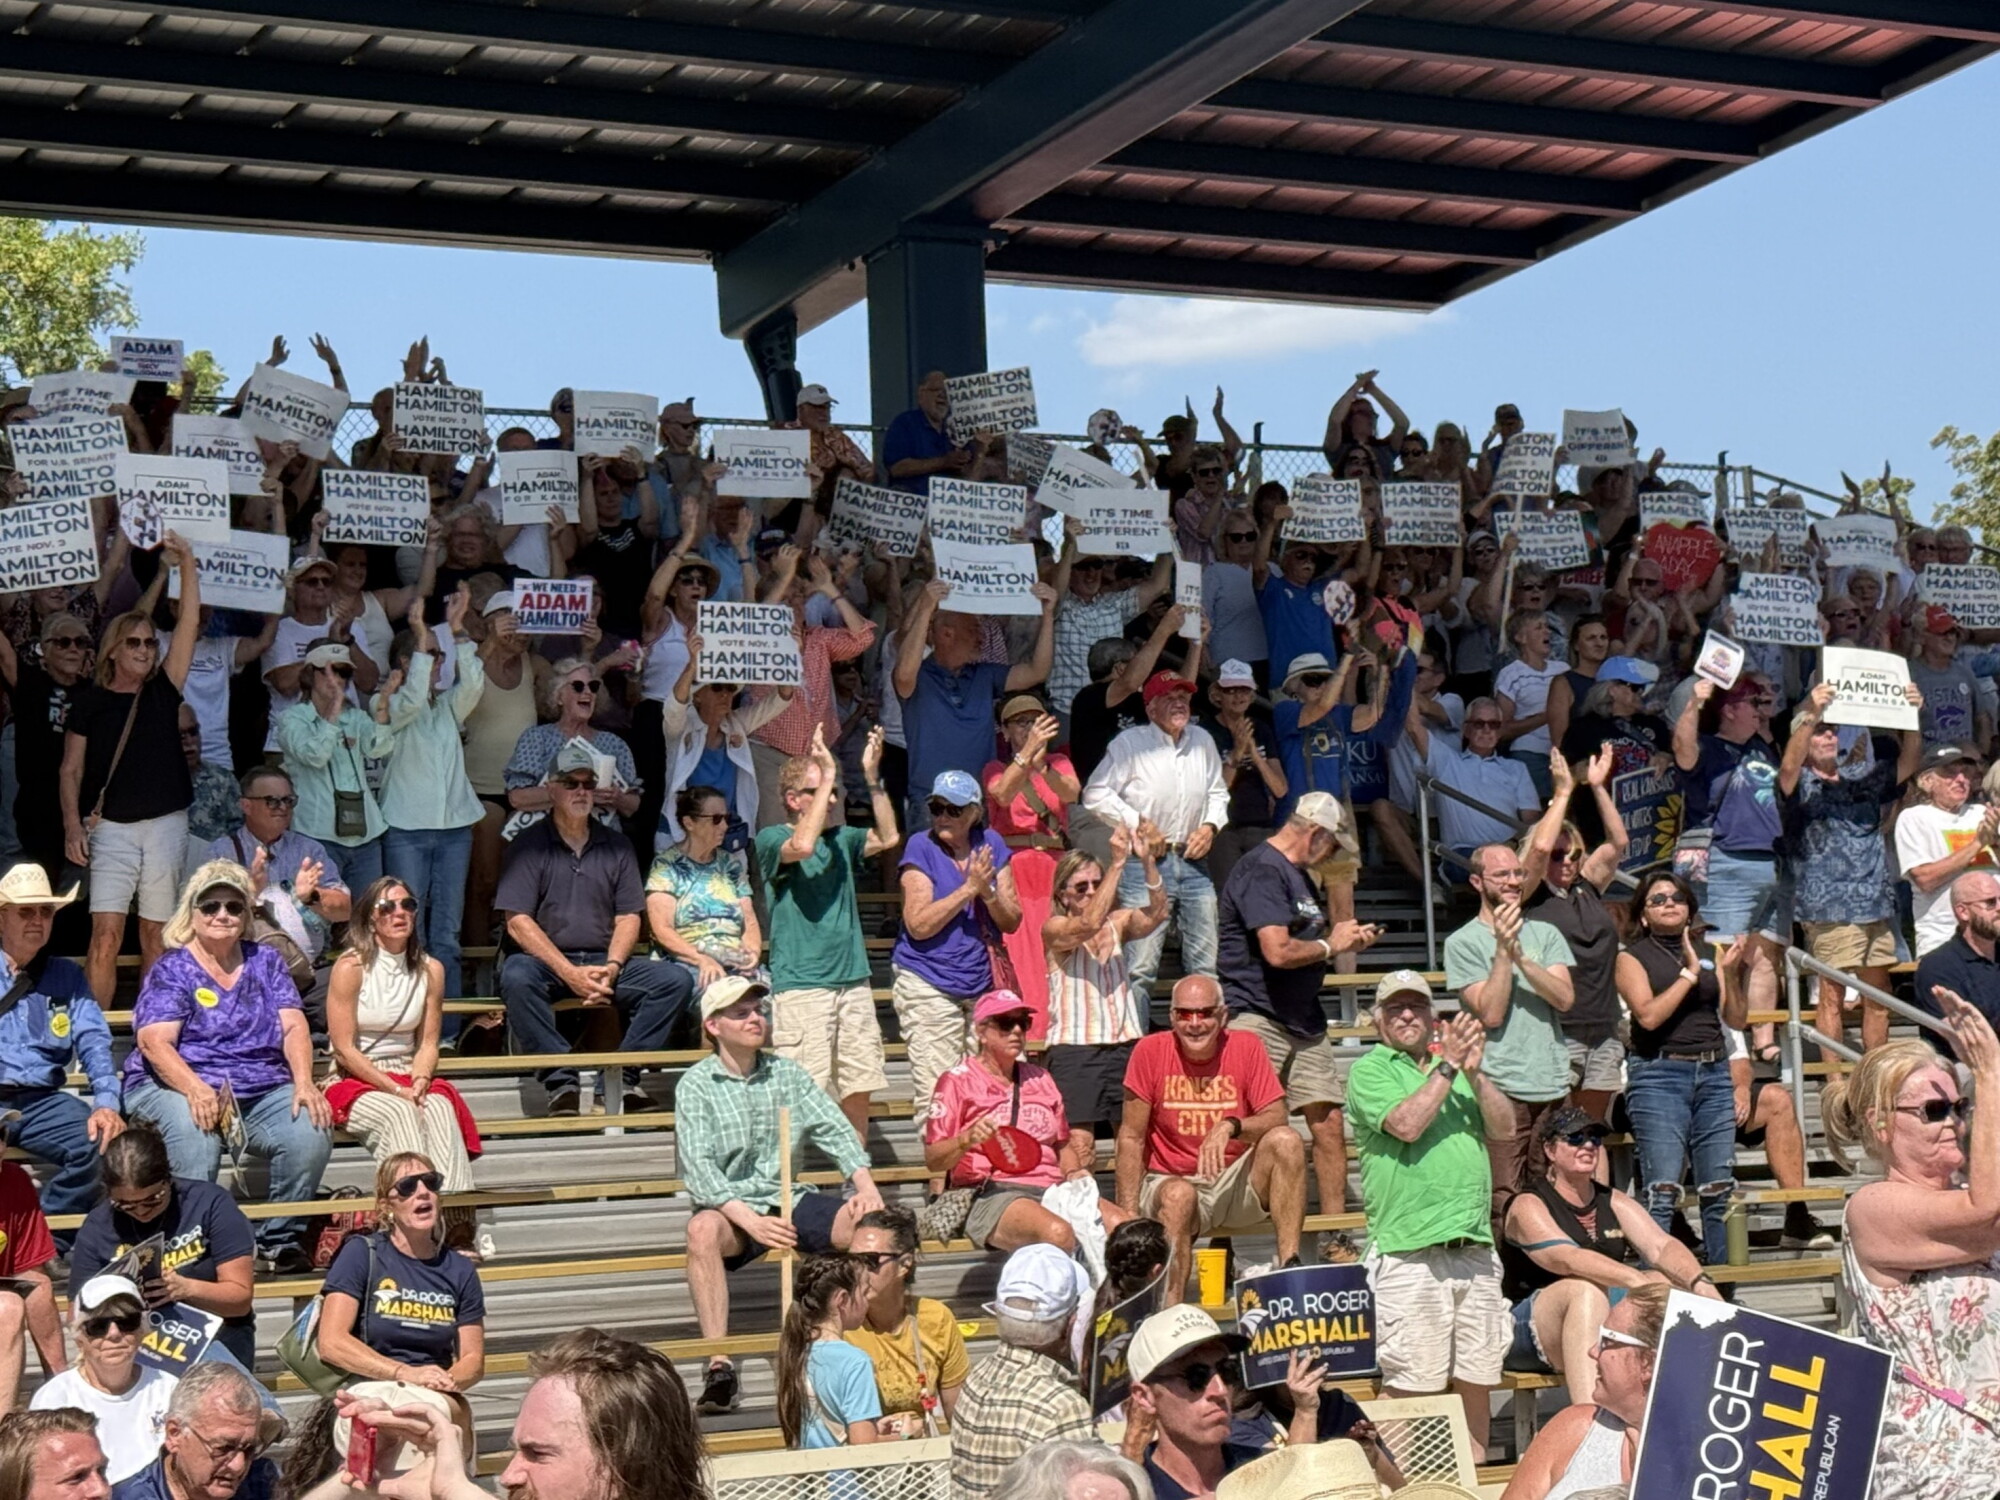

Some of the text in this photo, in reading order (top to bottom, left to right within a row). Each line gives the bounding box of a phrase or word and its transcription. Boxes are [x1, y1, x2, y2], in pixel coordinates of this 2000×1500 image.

[122, 342, 172, 354] ADAM
[946, 368, 1031, 392] HAMILTON
[76, 386, 113, 400] TIME
[396, 384, 482, 402] HAMILTON
[949, 382, 1032, 402] HAMILTON
[284, 395, 315, 408] ADAM
[396, 398, 483, 416] HAMILTON
[247, 392, 338, 432] HAMILTON
[412, 415, 436, 423] VOTE
[608, 410, 635, 418] ADAM
[954, 404, 1036, 428] HAMILTON
[11, 419, 122, 441] HAMILTON
[396, 424, 482, 440] HAMILTON
[15, 434, 124, 454] HAMILTON
[213, 438, 239, 448] ADAM
[748, 448, 776, 456] ADAM
[27, 459, 49, 467] FOR
[716, 456, 808, 470] HAMILTON
[20, 464, 116, 484] HAMILTO
[326, 472, 426, 490] HAMILTON
[536, 471, 560, 479] ADAM
[18, 479, 117, 500] HAMILTO
[156, 480, 190, 490] ADAM
[503, 480, 576, 494] HAMILTON
[932, 478, 1024, 498] HAMILTON
[1384, 485, 1458, 496] HAMILTON
[120, 488, 226, 508] HAMILTON
[326, 486, 427, 503] HAMILTON
[504, 495, 531, 503] FOR
[838, 480, 928, 508] HAMILTON
[836, 490, 925, 520] HAMILTON
[932, 494, 1024, 514] HAMILTON
[1384, 498, 1458, 508] HAMILTON
[0, 500, 87, 526] MILTON
[160, 507, 227, 518] KANSAS
[330, 512, 427, 530] HAMILTON
[1090, 508, 1154, 519] IT'S TIME
[1724, 510, 1806, 522] HAMILTON
[0, 516, 89, 544] MILTON
[832, 514, 918, 542] HAMILTON
[930, 518, 1012, 536] HAMILTO
[1084, 527, 1160, 536] DIFFERENT
[1283, 526, 1363, 540] HAMILTON
[326, 528, 426, 545] HAMILTON
[1387, 532, 1458, 543] HAMILTON
[0, 545, 22, 556] OTE
[214, 550, 248, 561] ADAM
[195, 558, 284, 582] AMILTON
[940, 566, 1035, 584] HAMILTON
[968, 563, 998, 571] ADAM
[532, 582, 577, 593] WE NEED
[973, 584, 1028, 594] KANSA
[1750, 576, 1817, 592] MILTON
[519, 593, 587, 611] ADAM
[1742, 588, 1816, 604] AMILTON
[516, 611, 590, 627] HAMILTON
[700, 604, 792, 622] HAMILTON
[1736, 613, 1818, 630] HAMILTON
[700, 620, 792, 636] HAMILTON
[1734, 626, 1820, 643] HAMILTON
[718, 639, 745, 648] VOTE
[748, 640, 771, 648] NOV.
[700, 651, 798, 668] HAMILTON
[700, 666, 798, 682] HAMILTON
[1859, 672, 1886, 680] ADAM
[1834, 694, 1904, 706] OR KANSA
[1346, 740, 1376, 765] KU
[1164, 1074, 1238, 1102] KANSAS
[1178, 1110, 1224, 1136] CITY
[164, 1225, 202, 1251] ROGER
[162, 1239, 206, 1268] HALL
[376, 1300, 456, 1322] MARSHALL
[1268, 1290, 1370, 1320] DR. ROGER
[1176, 1313, 1204, 1323] TEAM
[148, 1310, 202, 1344] OGER
[1248, 1314, 1370, 1356] MARSHALL
[1692, 1331, 1765, 1500] ROGER
[1746, 1356, 1826, 1500] HALL
[1814, 1414, 1842, 1500] REPUBLICAN
